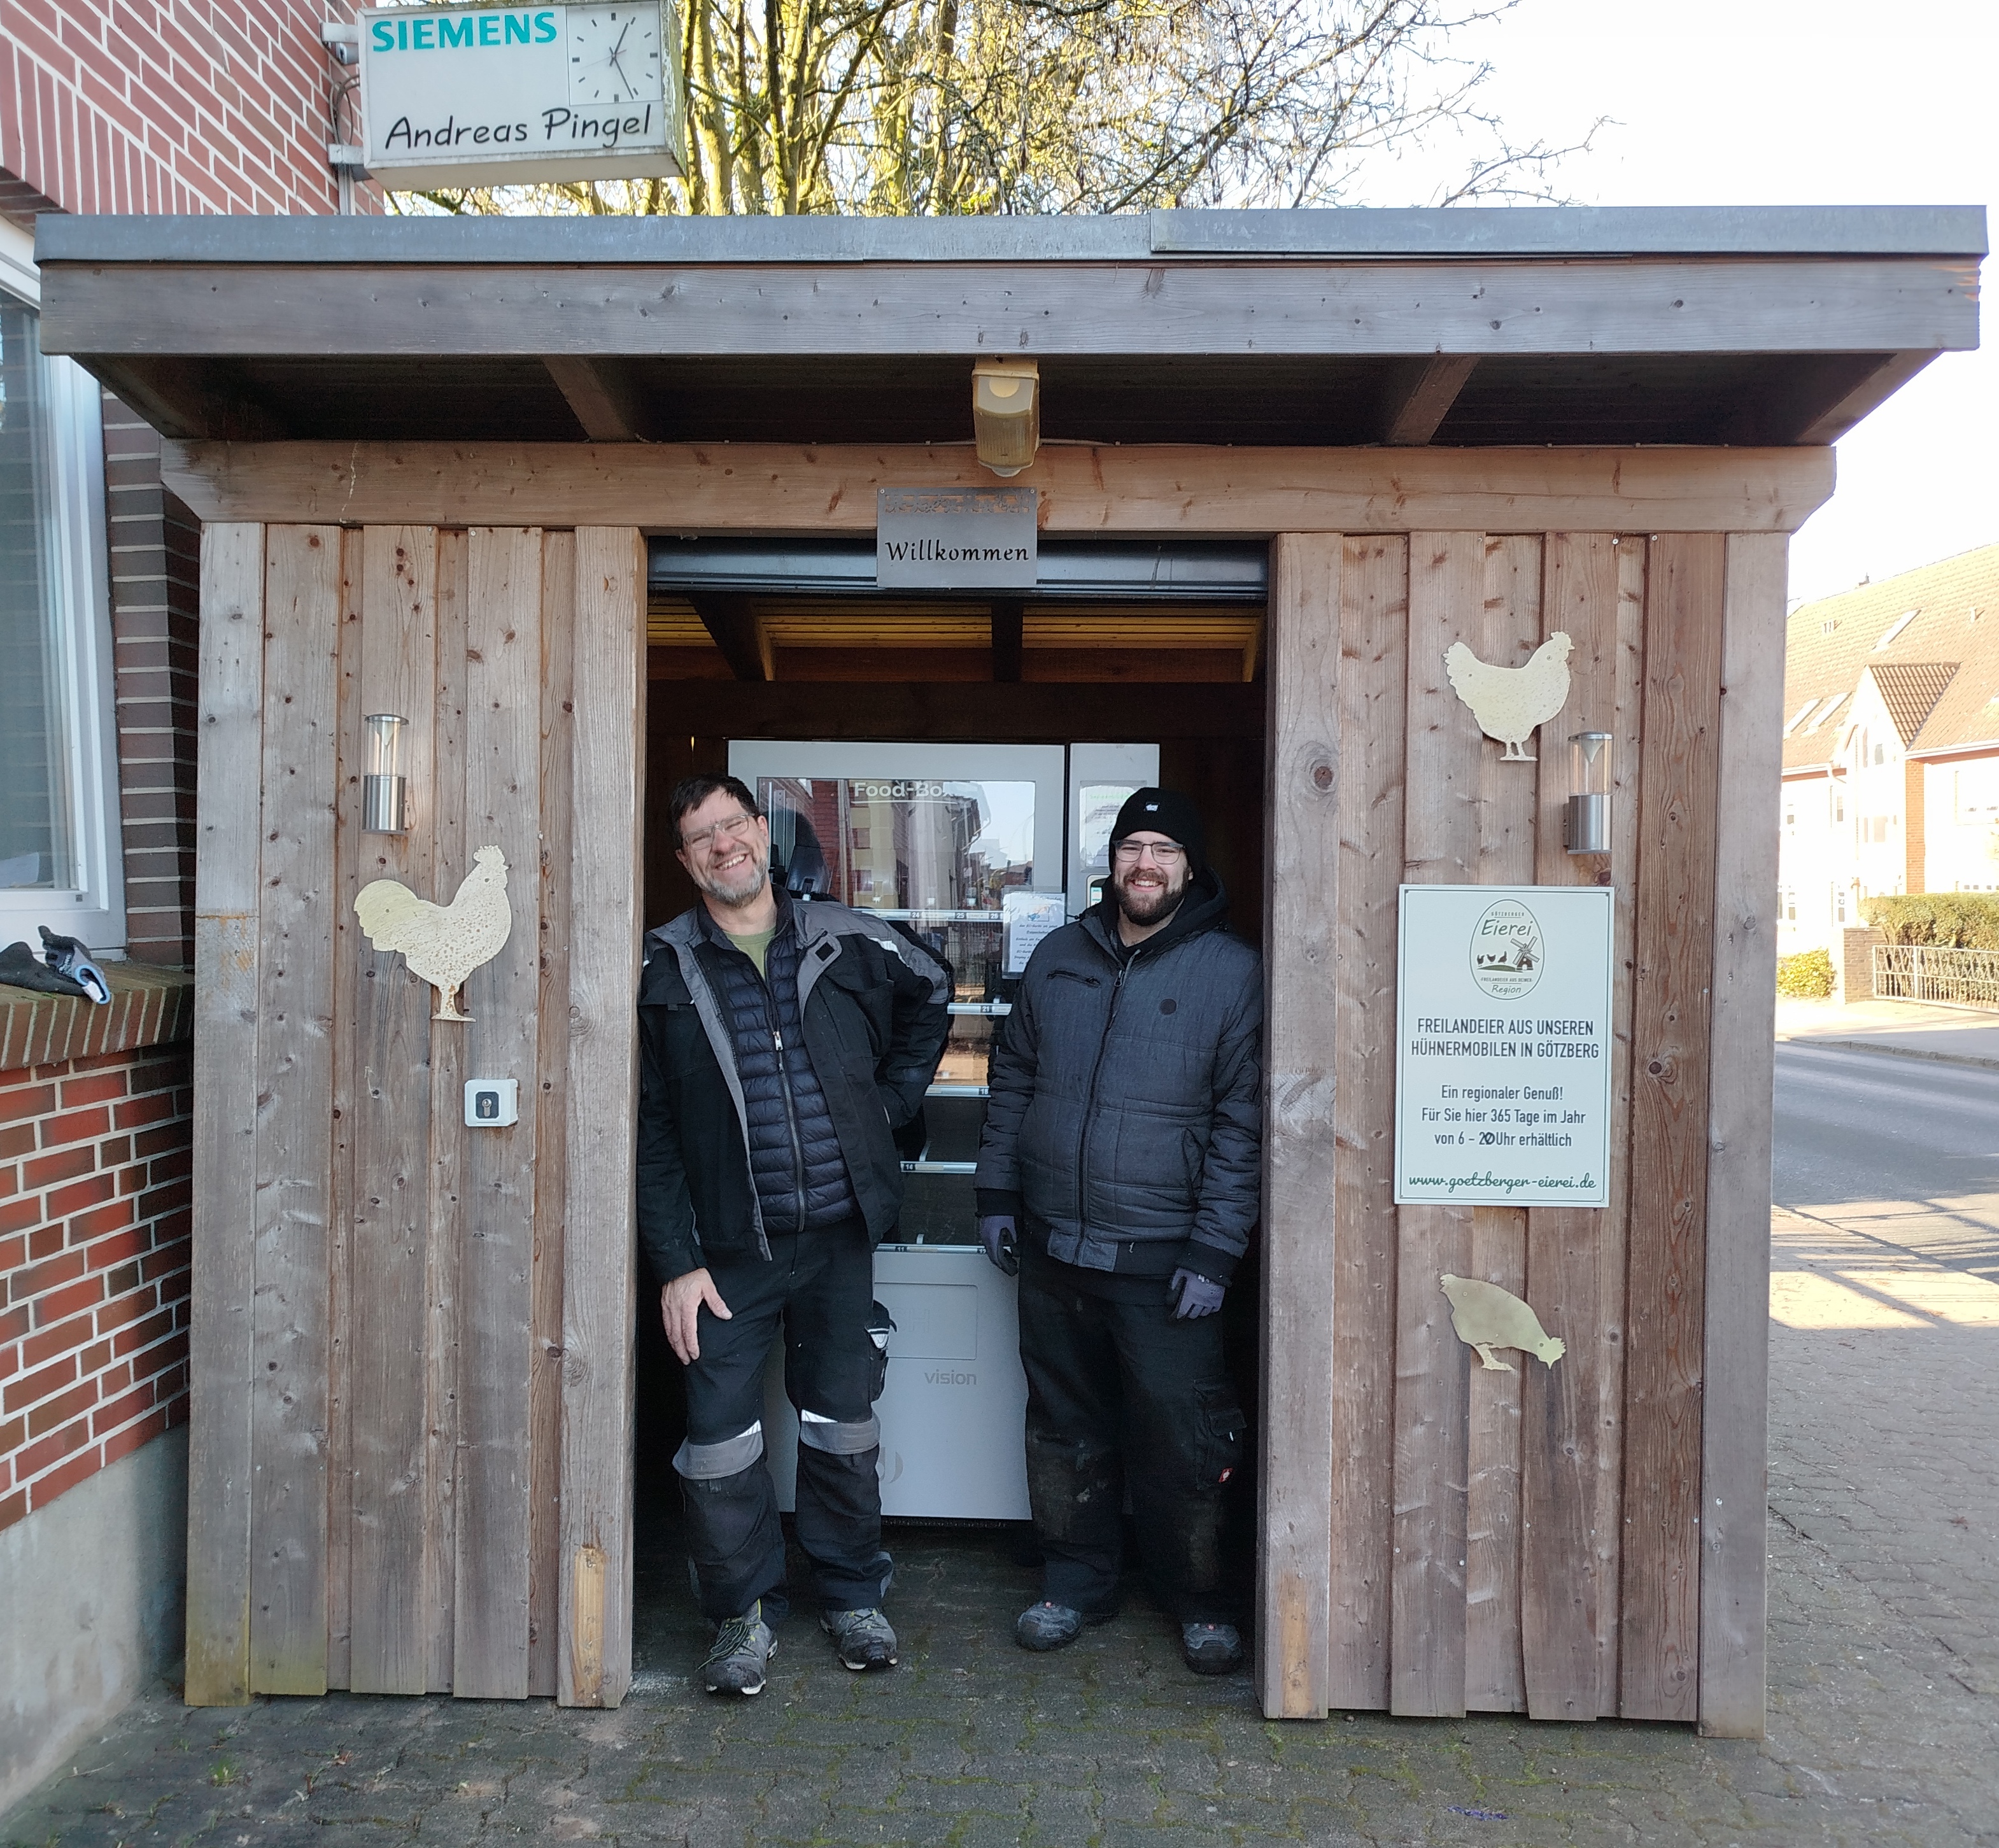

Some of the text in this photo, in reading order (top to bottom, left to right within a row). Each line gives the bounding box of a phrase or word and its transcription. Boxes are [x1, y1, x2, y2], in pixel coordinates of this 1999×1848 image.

[372, 11, 558, 53] SIEMENS
[385, 104, 651, 150] Andreas Pingel
[885, 539, 1029, 561] Willkommen
[1481, 919, 1534, 936] Eierei
[1492, 984, 1522, 995] Region
[1417, 1018, 1593, 1036] FREILANDEIER AUS UNSEREN
[1411, 1038, 1600, 1058] HÜHNERMOBILEN IN GÖTZBERG
[1441, 1085, 1564, 1102] Ein regionaler Genuß!
[1422, 1107, 1586, 1126] Für Sie hier 365 Tage im Jahr
[1434, 1133, 1454, 1145] von
[1459, 1131, 1465, 1145] 6
[1519, 1132, 1572, 1146] erhältlich
[1409, 1171, 1597, 1194] www.goetzberger-eierei.de
[924, 1369, 977, 1385] vision
